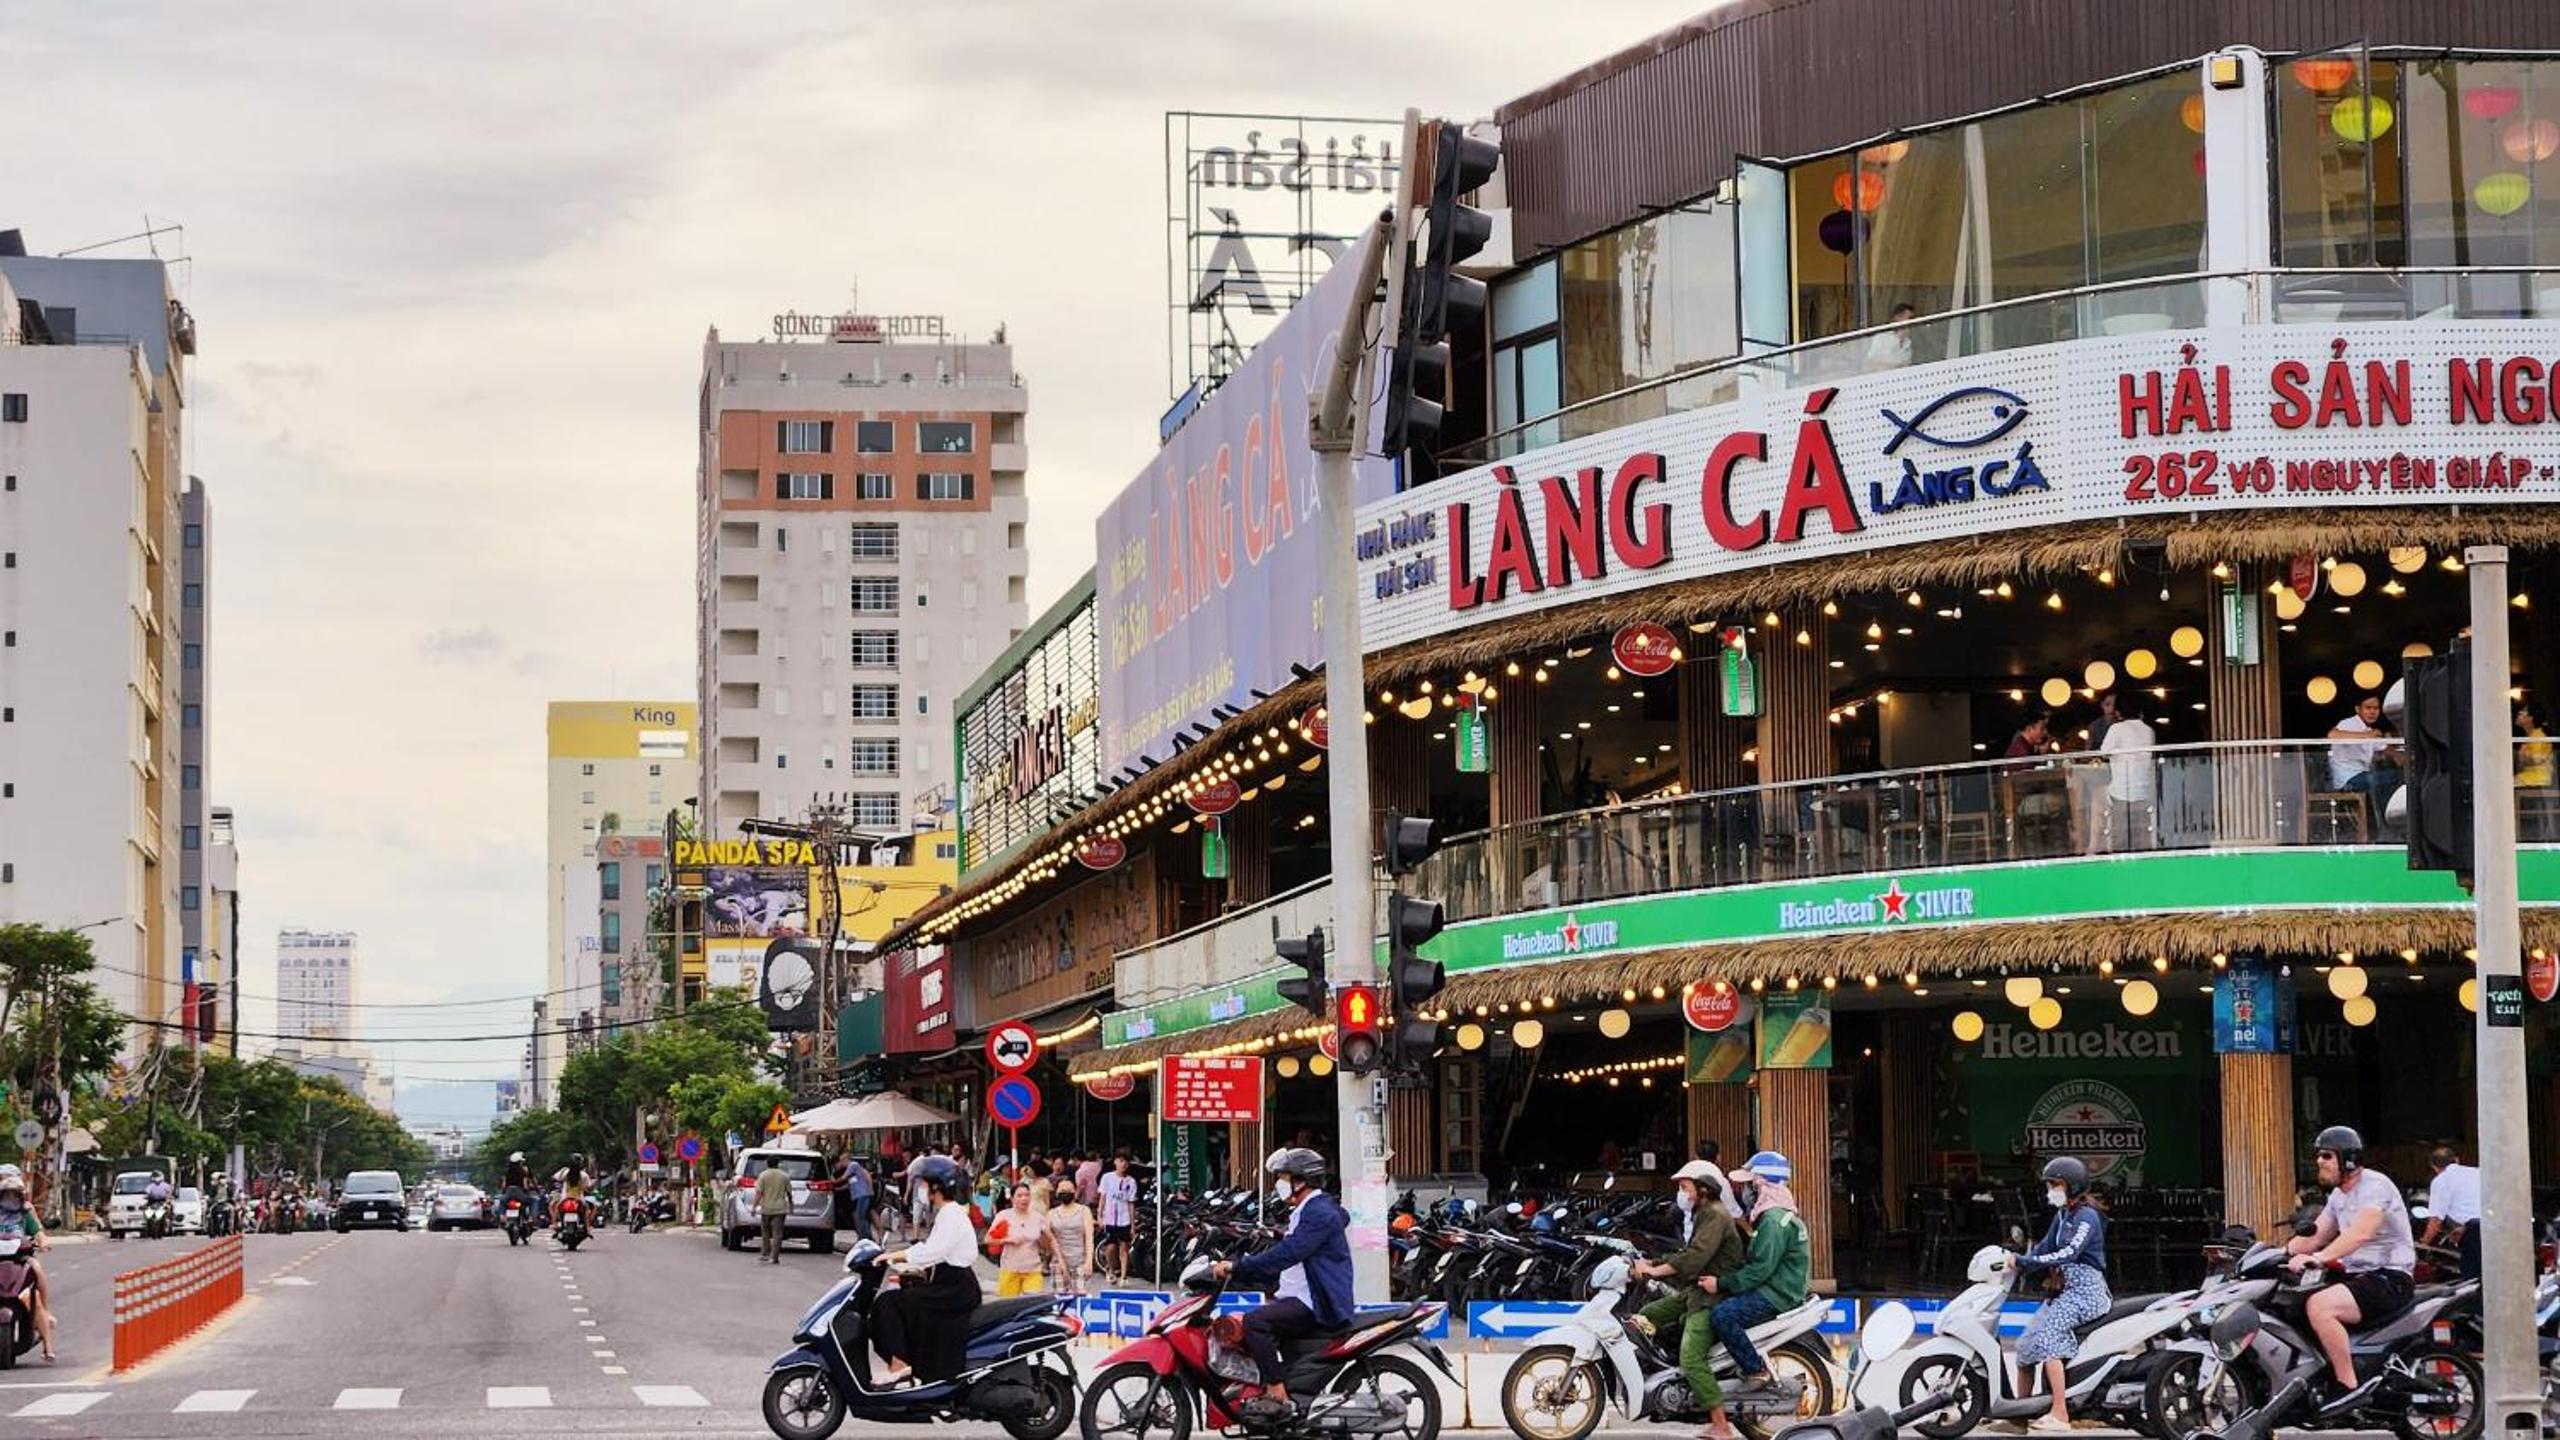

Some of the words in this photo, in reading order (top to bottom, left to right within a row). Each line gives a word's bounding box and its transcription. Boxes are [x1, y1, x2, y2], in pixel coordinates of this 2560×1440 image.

[888, 315, 951, 338] HOTEL
[2118, 343, 2232, 439] HẢI
[2270, 338, 2413, 429] SẢN
[2449, 356, 2560, 426] NG
[1869, 457, 1976, 515] LÀNG
[1979, 440, 2051, 496] CÁ
[2123, 450, 2219, 500] 262
[2286, 452, 2437, 493] NGUYÊN
[2445, 451, 2533, 490] GIÁP
[1150, 438, 1236, 642] LÀNG
[1242, 357, 1294, 566] CÁ
[1446, 465, 1674, 611] LÀNG
[1701, 386, 1867, 552] CÁ
[633, 706, 676, 727] King
[675, 839, 762, 866] PANDA
[767, 839, 817, 867] SPA
[1779, 896, 1876, 930] Heineken
[1915, 887, 1975, 919] SILVER
[1502, 927, 1563, 959] Heineken
[1582, 919, 1619, 950] SILVER
[1982, 1021, 2183, 1060] Heineken
[2031, 1127, 2142, 1150] Heineken
